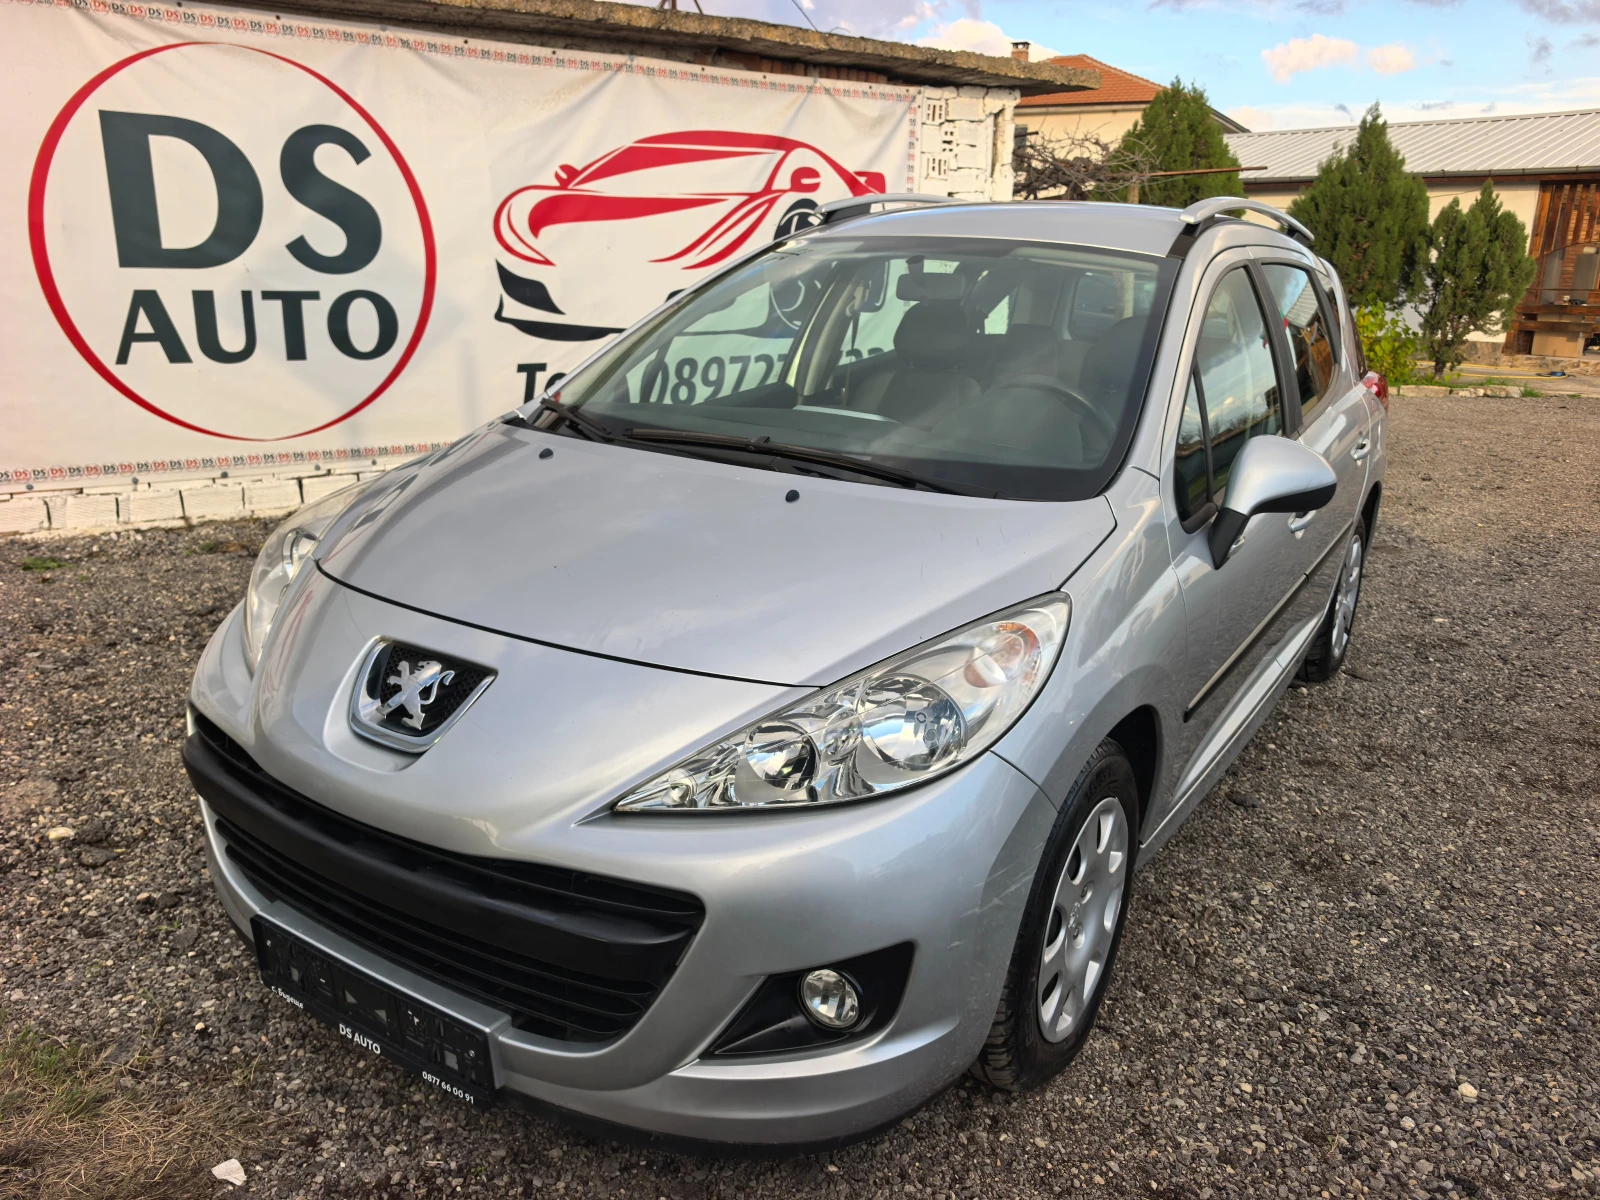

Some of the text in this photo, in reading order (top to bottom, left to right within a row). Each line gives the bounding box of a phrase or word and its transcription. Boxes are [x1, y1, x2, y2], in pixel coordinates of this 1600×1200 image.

[98, 108, 382, 275] DS
[115, 289, 399, 365] AUTO
[339, 1023, 381, 1055] DS AUTO
[422, 1070, 475, 1105] 0877 66 00 91
